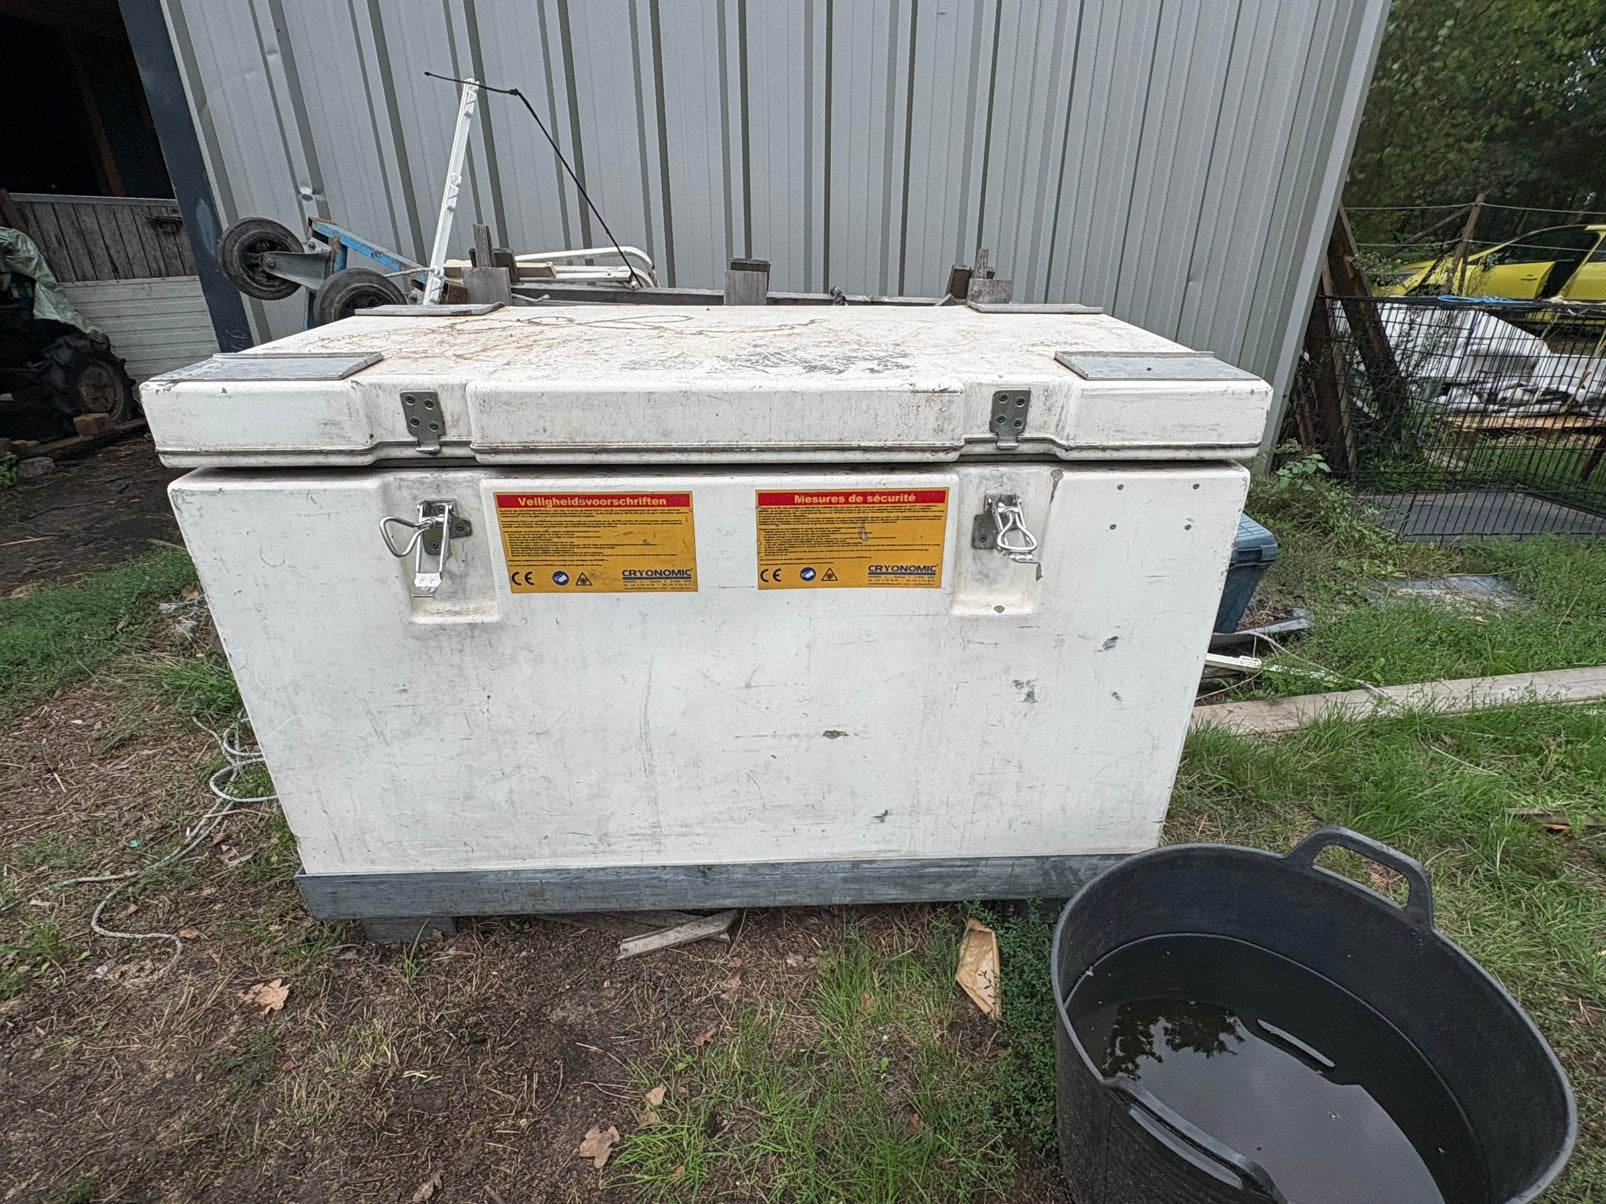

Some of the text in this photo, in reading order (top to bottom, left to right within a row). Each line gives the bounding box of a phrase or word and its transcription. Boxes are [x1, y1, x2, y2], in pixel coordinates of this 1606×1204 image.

[518, 496, 667, 508] Veiligheidsvoorschriften
[794, 493, 916, 503] Mesures de sécurité
[622, 569, 692, 577] CRYONOMIC
[868, 564, 936, 573] CRYONOMIC
[511, 571, 535, 586] CE
[760, 568, 782, 583] CE
